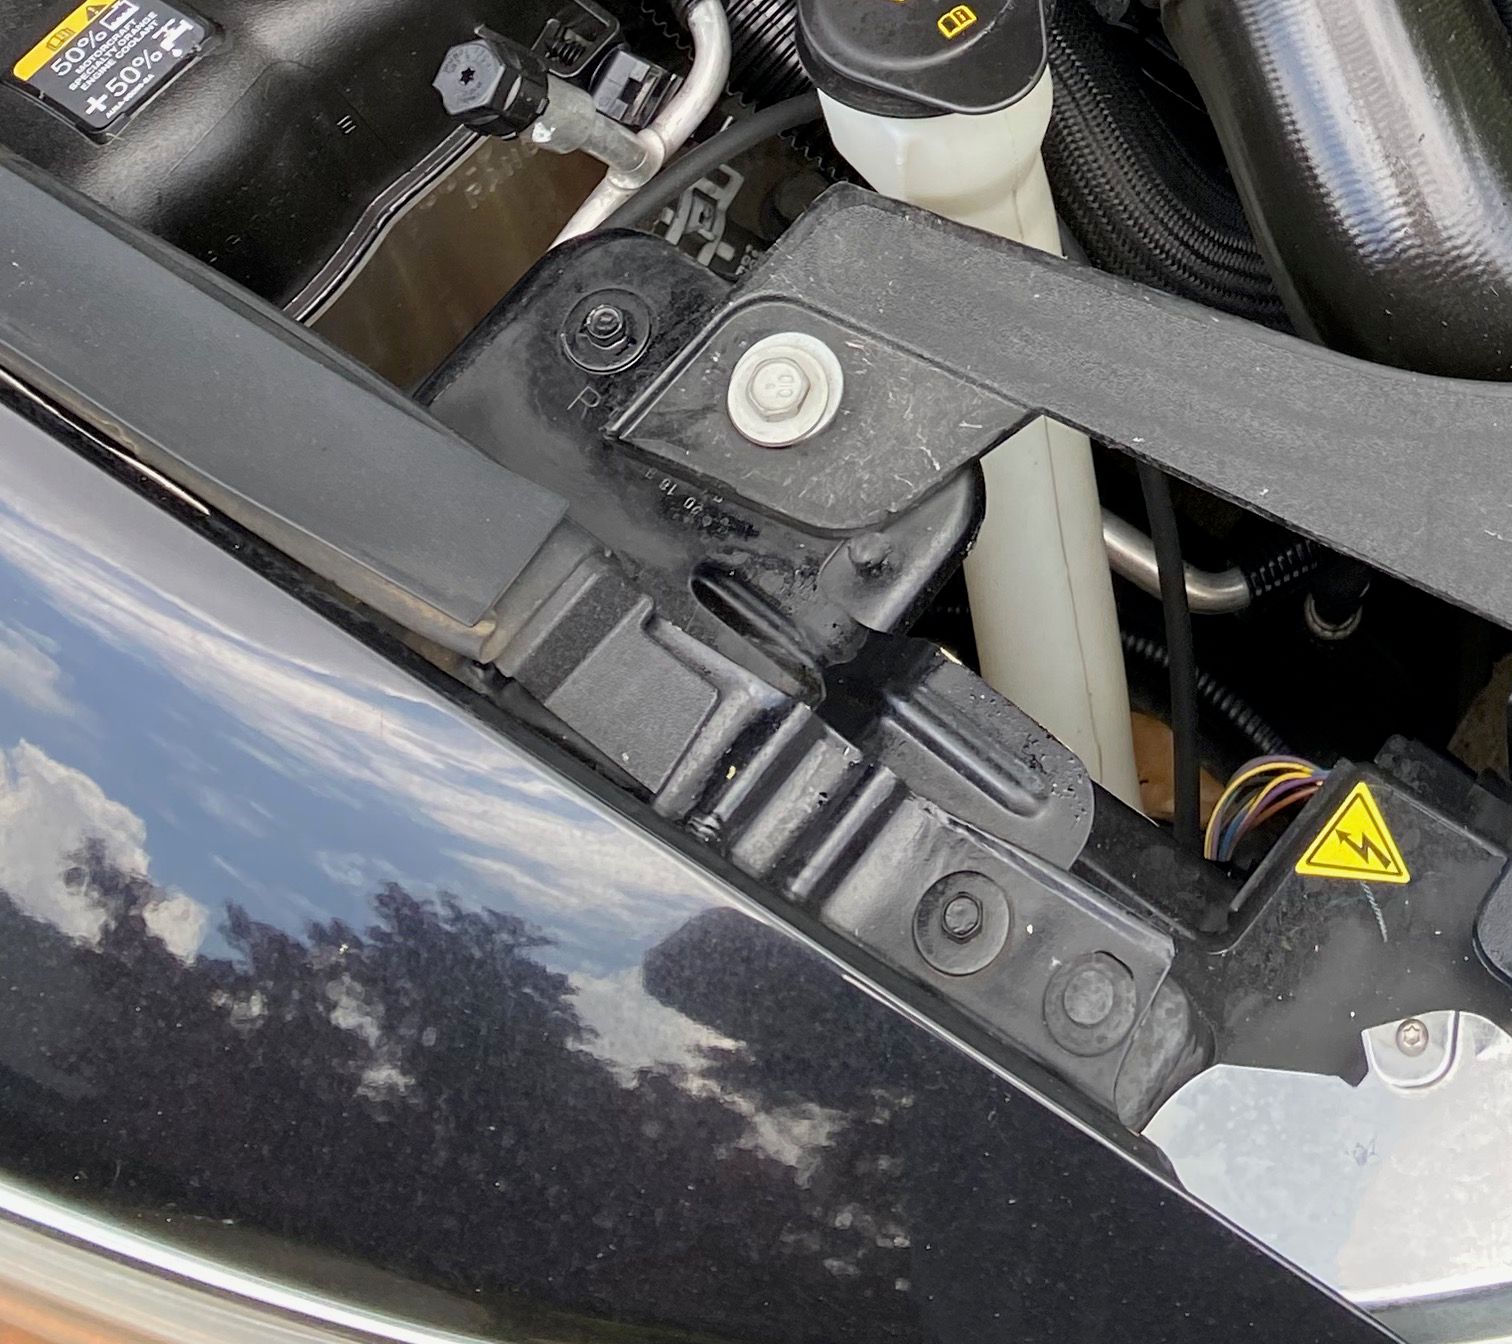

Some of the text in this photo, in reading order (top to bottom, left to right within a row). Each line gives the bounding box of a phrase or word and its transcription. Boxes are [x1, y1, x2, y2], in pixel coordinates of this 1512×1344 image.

[51, 30, 107, 76] 50%
[69, 11, 158, 91] SPECIALTY ORANGE
[75, 19, 137, 74] MOTORCRAFT
[80, 20, 159, 91] ENGINE COOLANT
[567, 385, 601, 420] R
